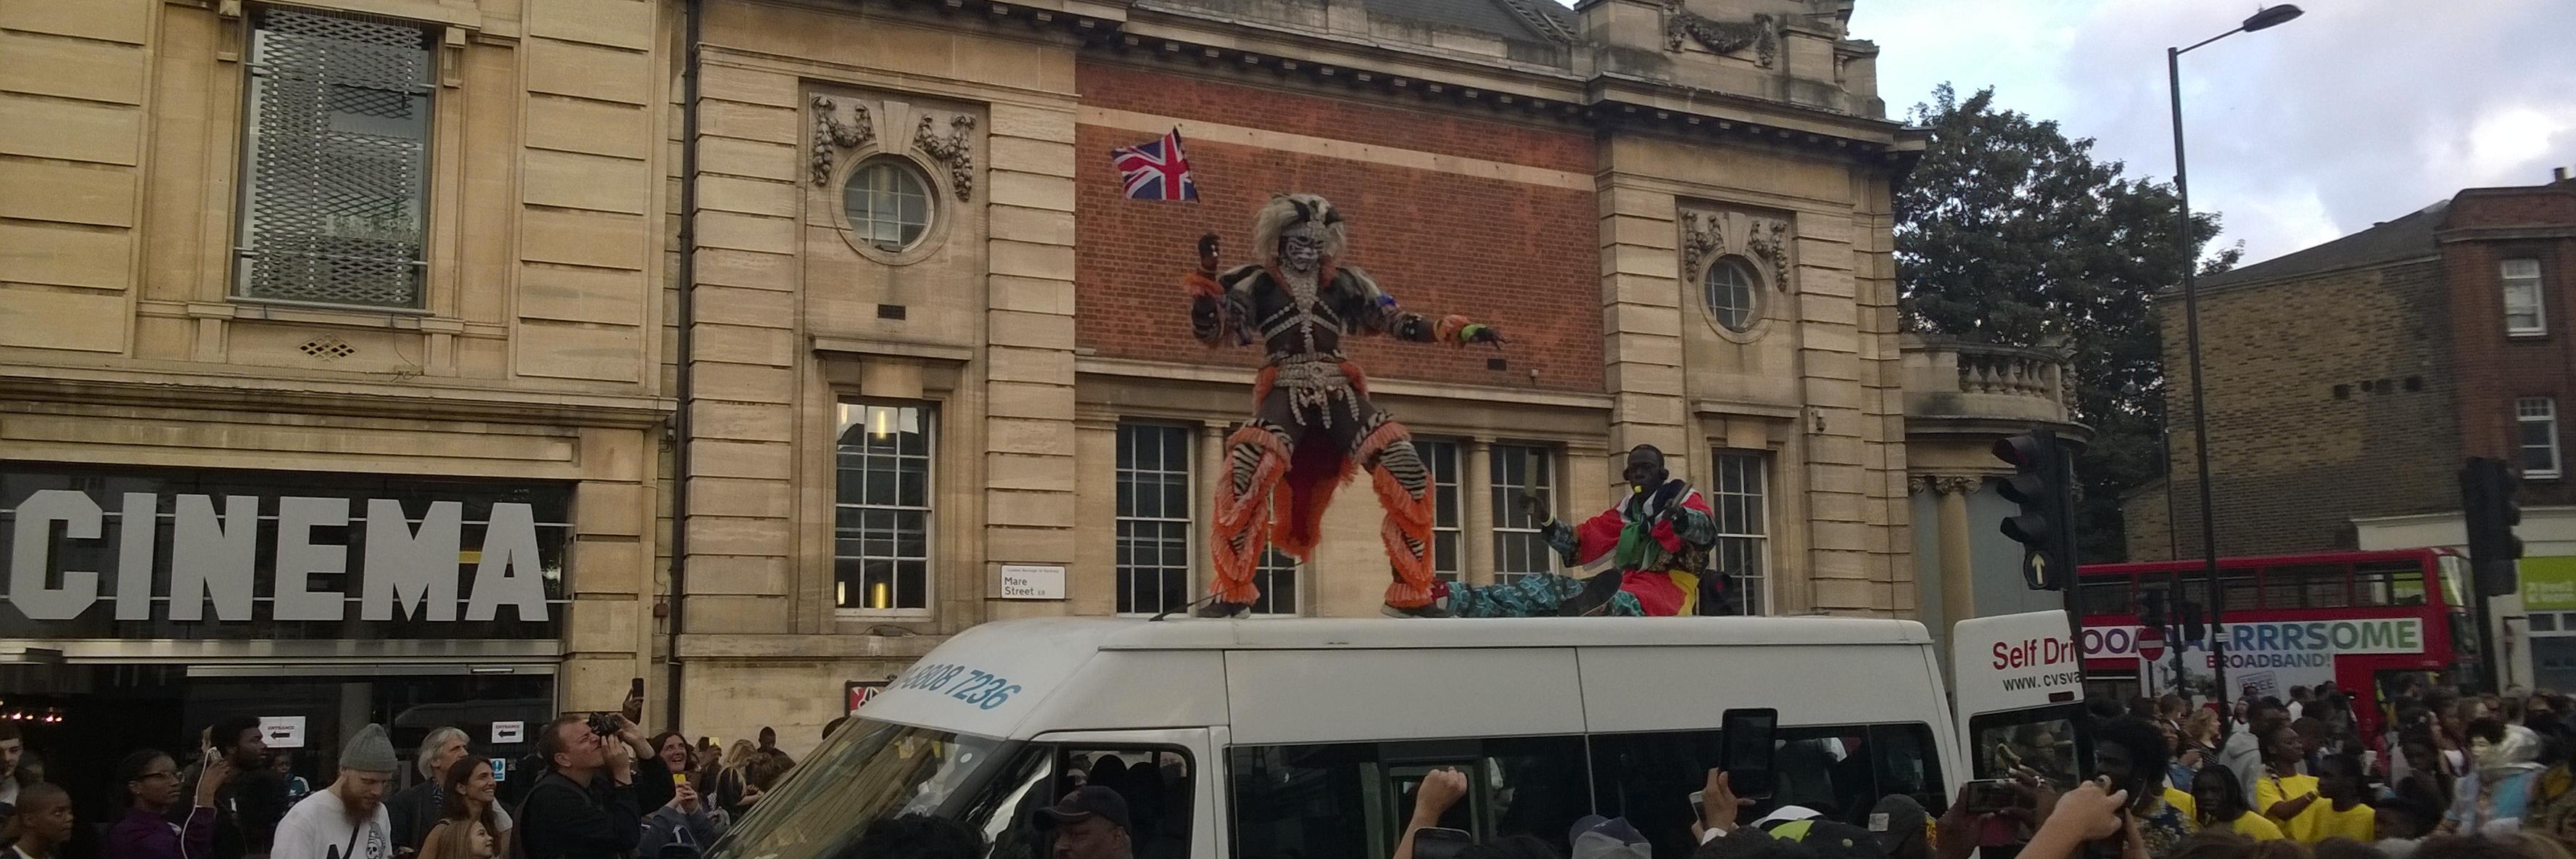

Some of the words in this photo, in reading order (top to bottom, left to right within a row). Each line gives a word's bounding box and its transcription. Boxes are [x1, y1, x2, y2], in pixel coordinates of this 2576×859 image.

[9, 490, 549, 622] CINEMA
[1004, 577, 1027, 585] Mare
[1004, 586, 1033, 596] Street
[1993, 639, 2037, 670] Self
[2206, 653, 2331, 669] BROADBAND!
[944, 670, 1022, 710] 7236
